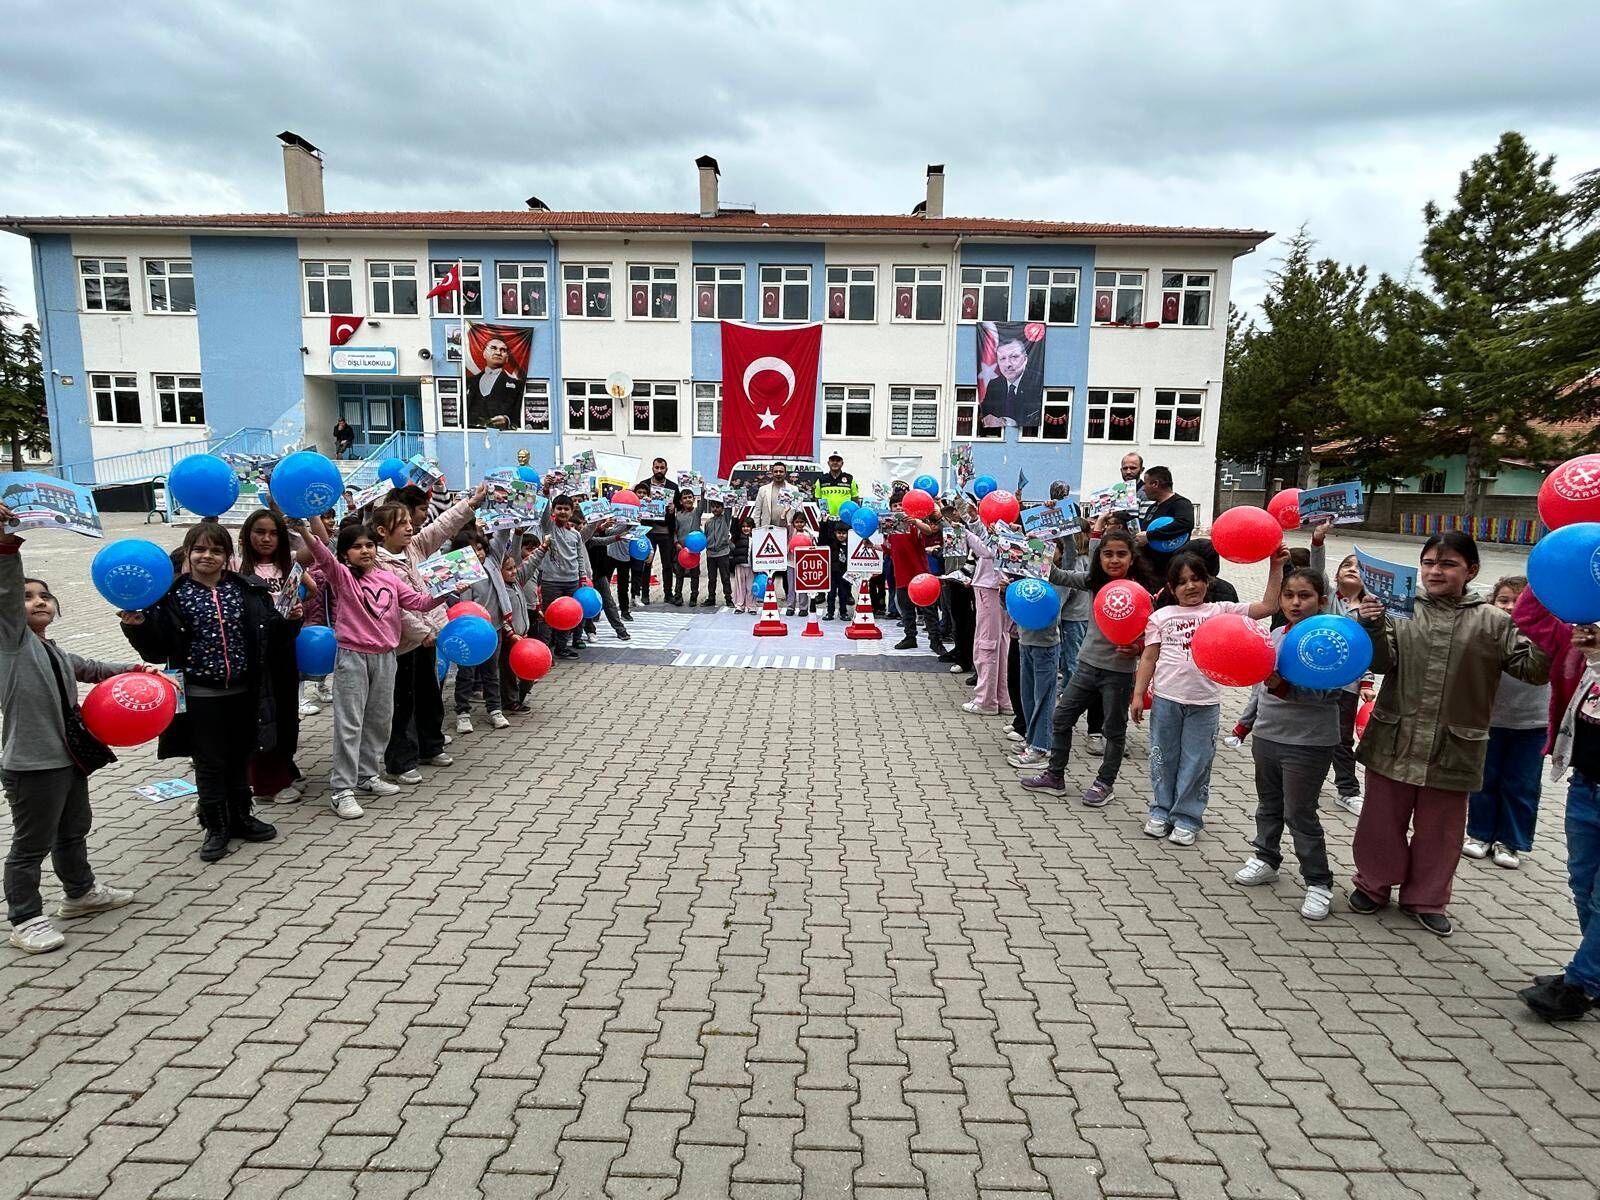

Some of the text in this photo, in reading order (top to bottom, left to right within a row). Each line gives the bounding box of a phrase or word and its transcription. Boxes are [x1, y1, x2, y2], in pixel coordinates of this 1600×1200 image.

[347, 359, 391, 367] DİŞLİ İLKOKULU
[742, 463, 768, 471] TRAFİK
[802, 560, 823, 570] DUR
[802, 571, 823, 580] STOP
[1176, 618, 1196, 631] NOW
